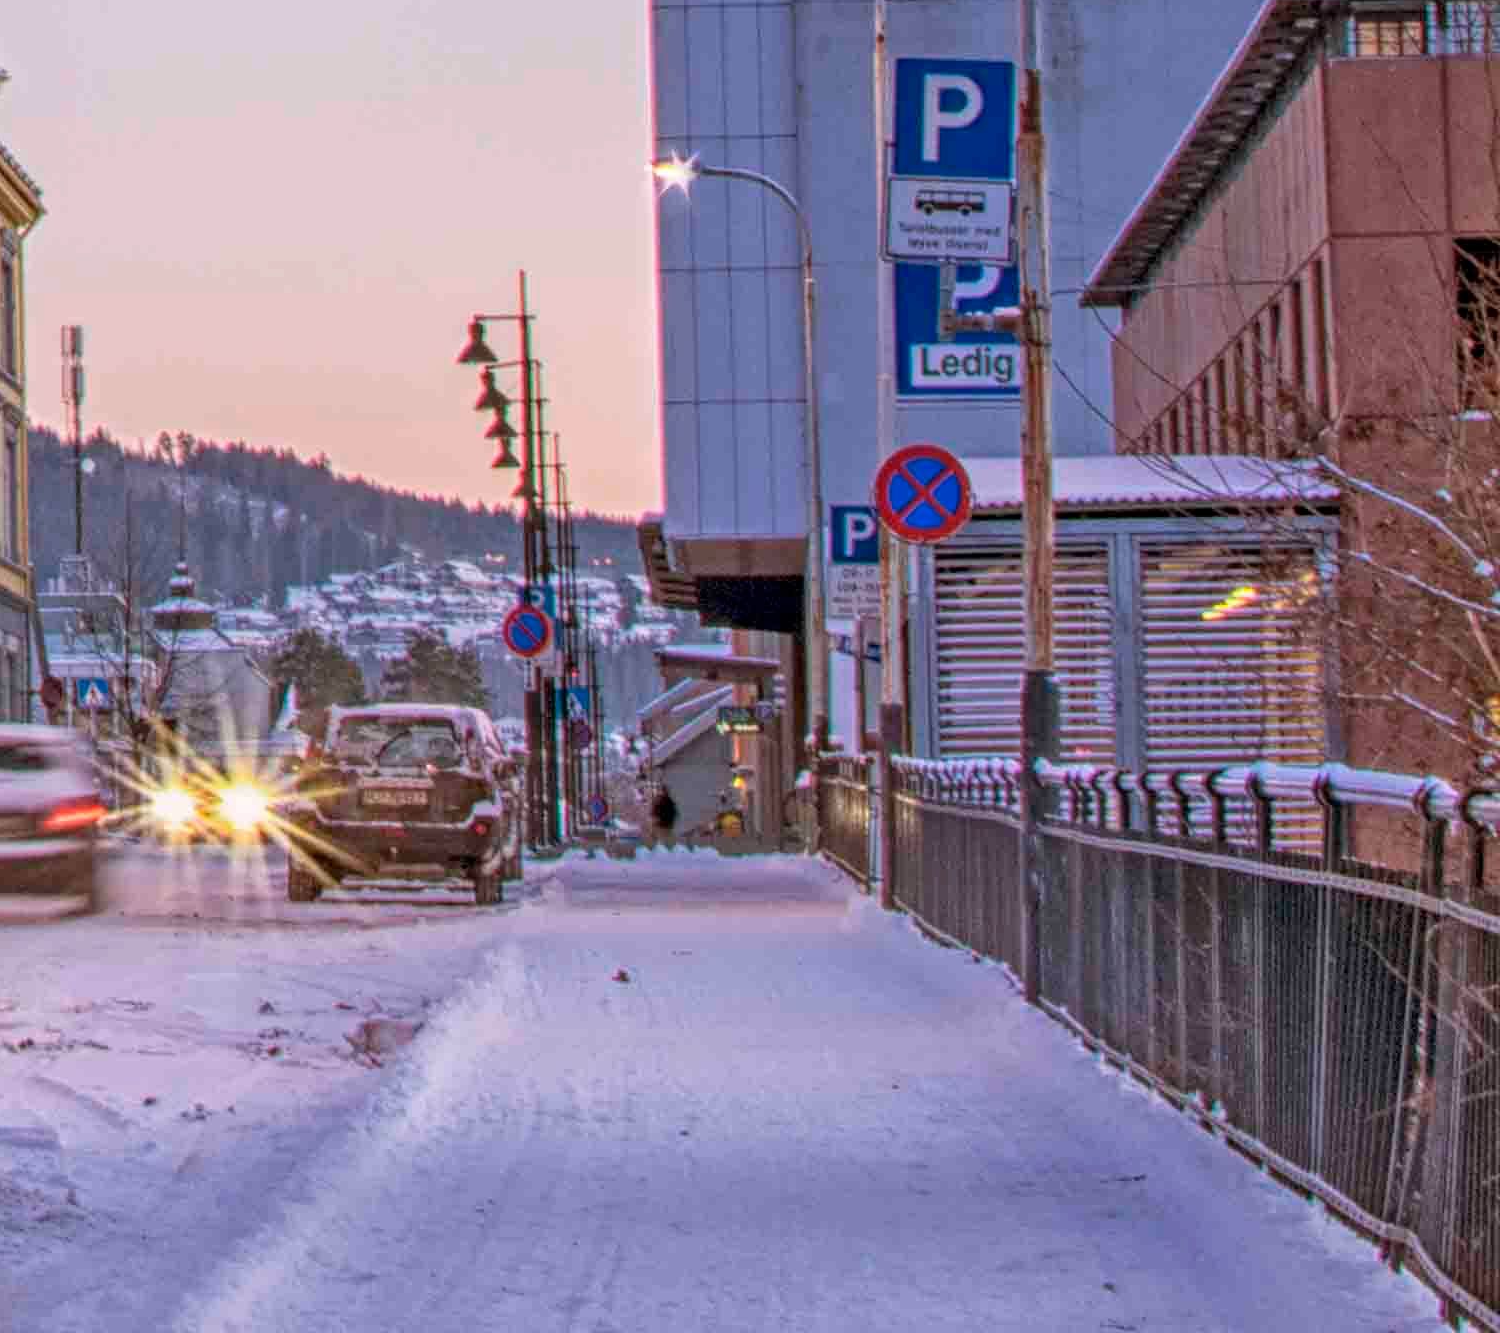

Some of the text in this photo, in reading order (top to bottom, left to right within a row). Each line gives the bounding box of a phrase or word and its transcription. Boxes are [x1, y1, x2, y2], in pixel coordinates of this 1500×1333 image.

[921, 74, 983, 162] P
[920, 346, 1014, 384] Ledig
[844, 513, 876, 556] P
